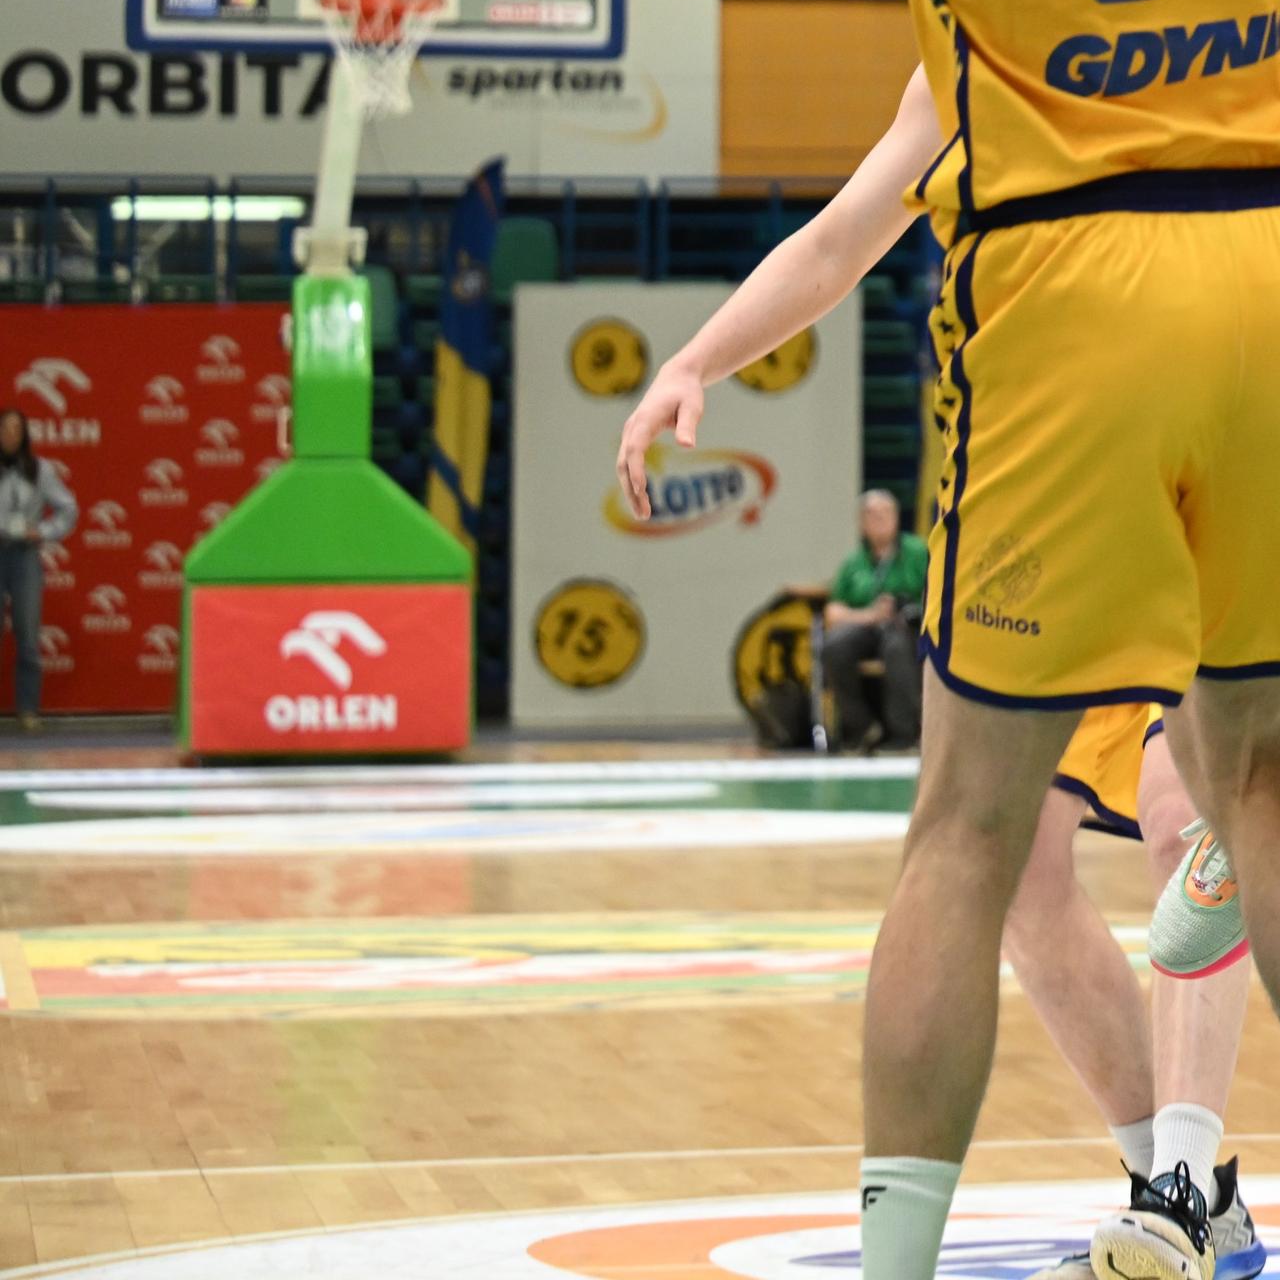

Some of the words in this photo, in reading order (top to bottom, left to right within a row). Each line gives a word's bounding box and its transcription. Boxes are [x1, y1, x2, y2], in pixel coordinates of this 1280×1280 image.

[28, 419, 101, 446] RLEN
[964, 603, 1041, 636] albinos
[265, 695, 398, 732] ORLEN
[861, 1186, 887, 1212] F
